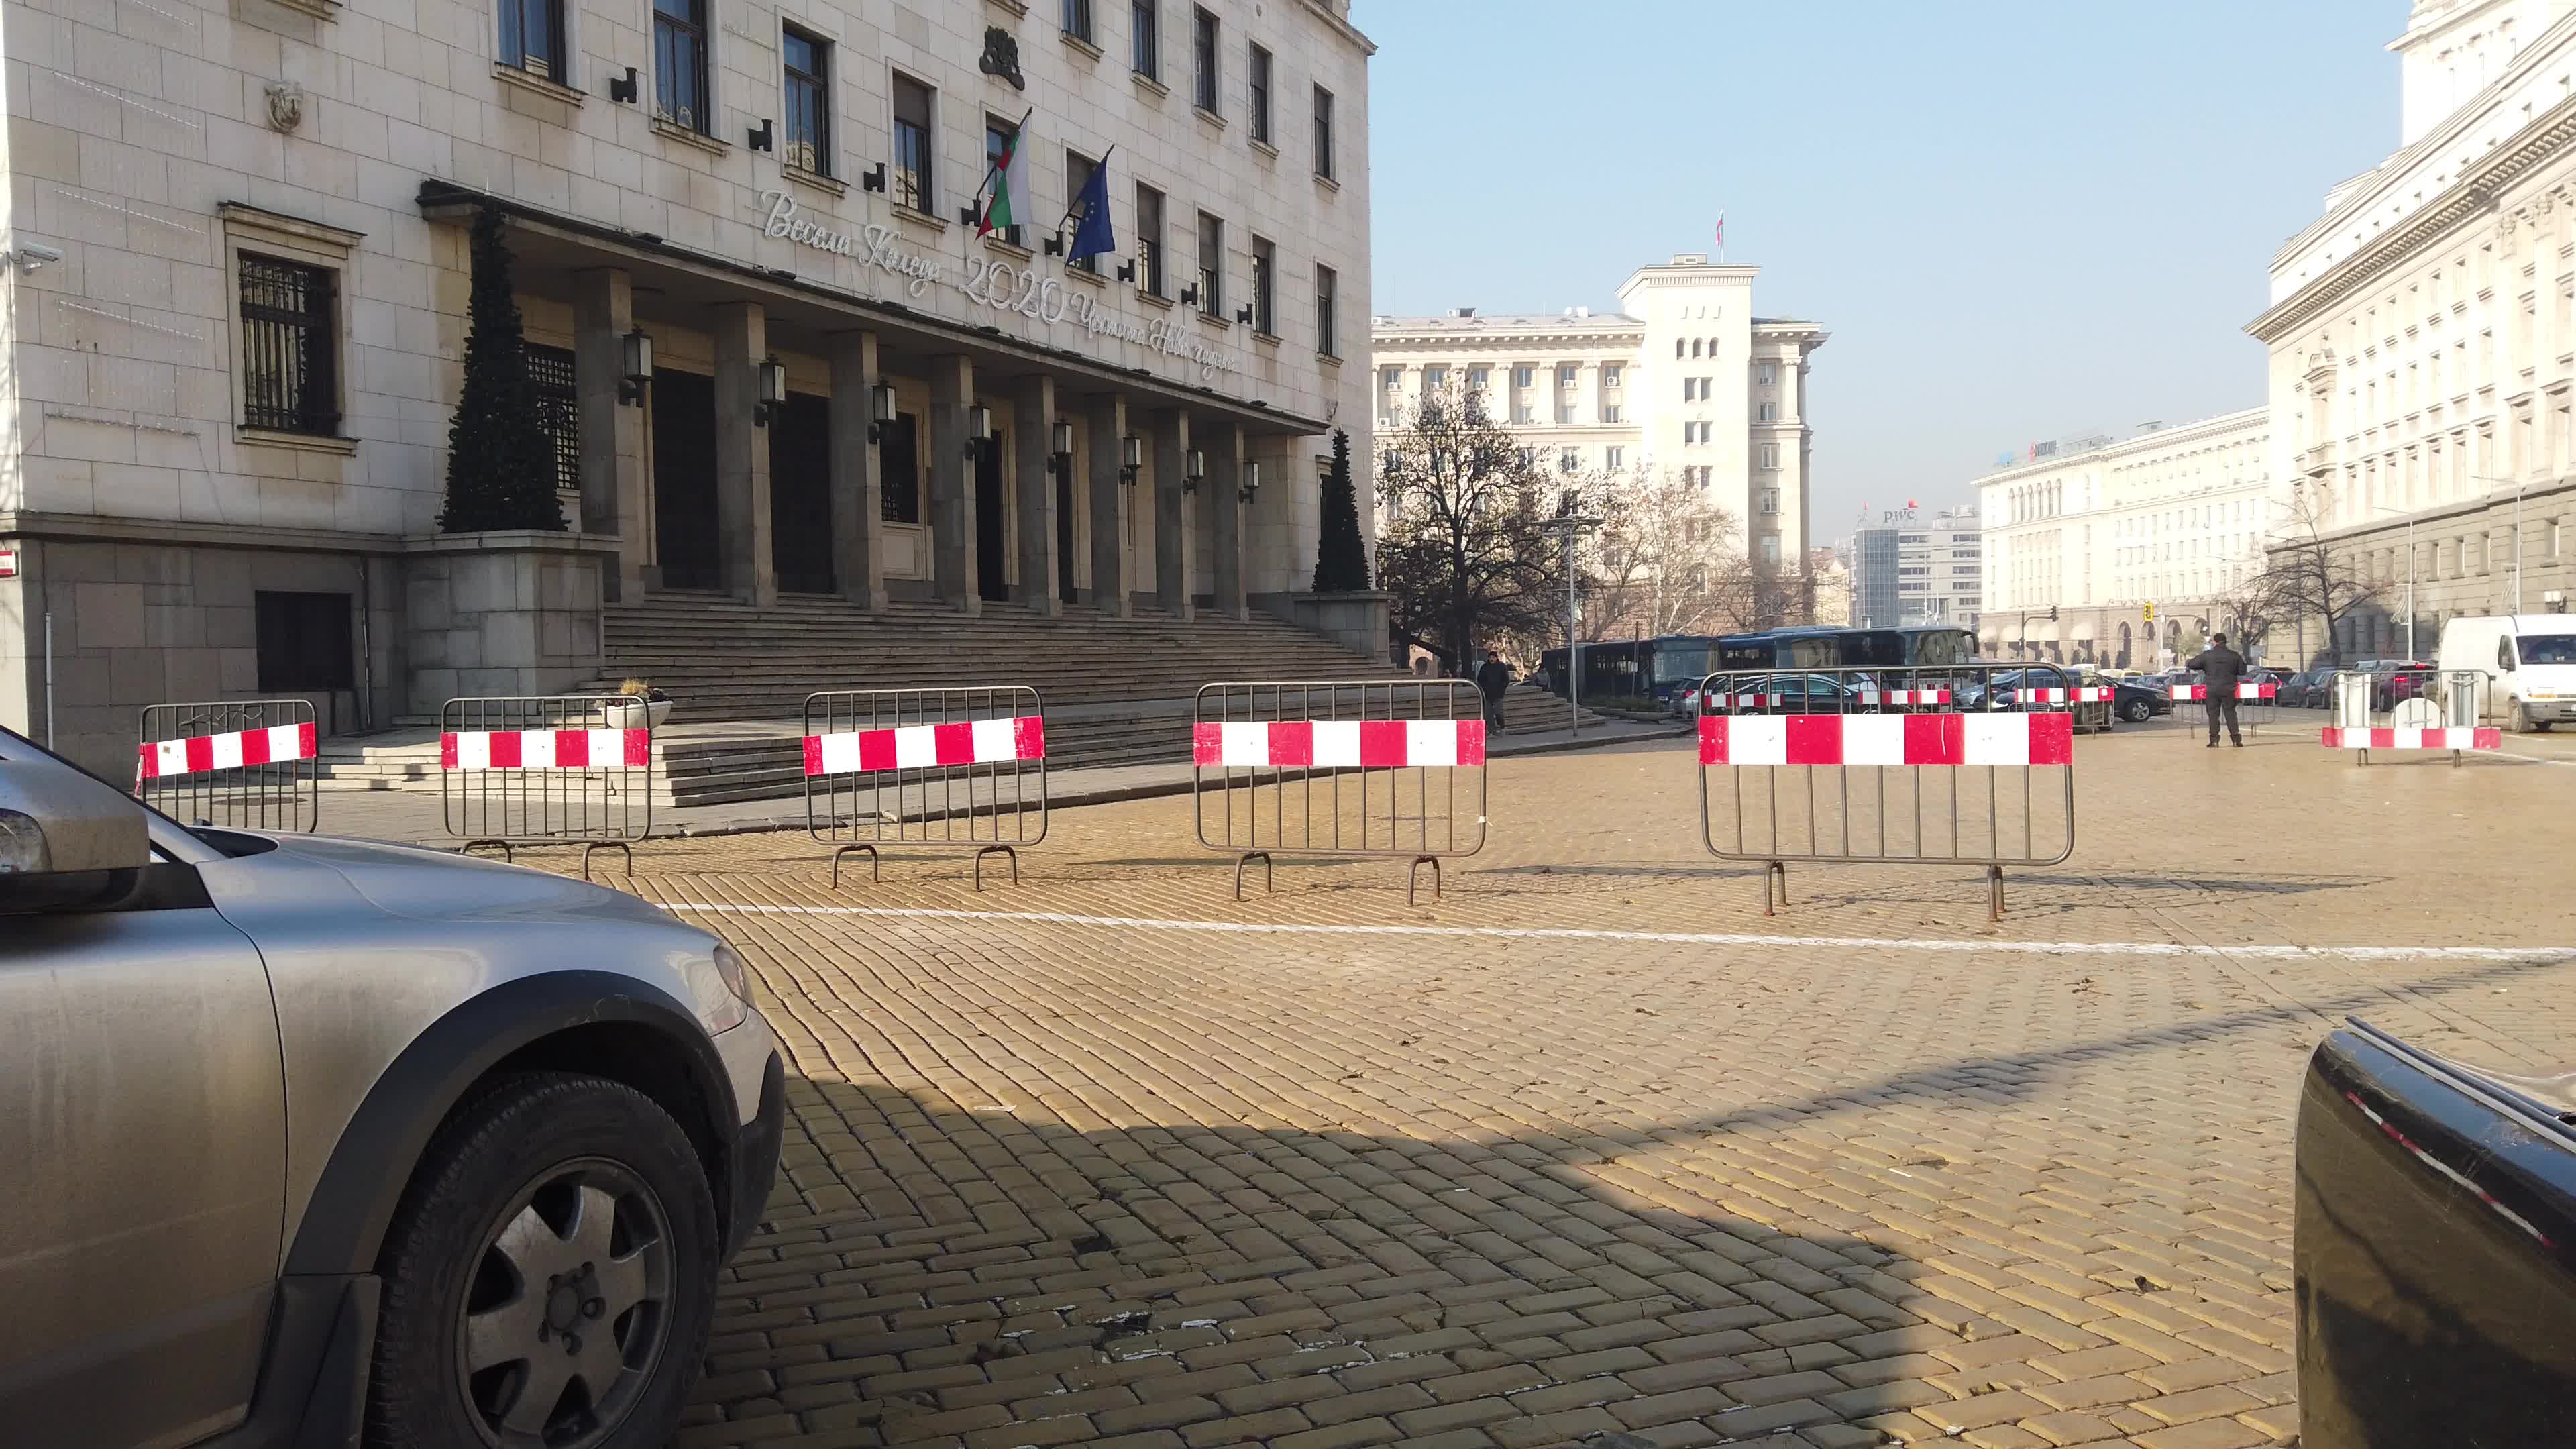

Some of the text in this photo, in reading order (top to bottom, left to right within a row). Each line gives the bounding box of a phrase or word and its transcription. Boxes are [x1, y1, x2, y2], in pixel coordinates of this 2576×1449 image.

[858, 223, 943, 298] Коледа
[958, 254, 1067, 325] 2020
[1150, 317, 1189, 357] Нова
[1883, 508, 1916, 523] pwc
